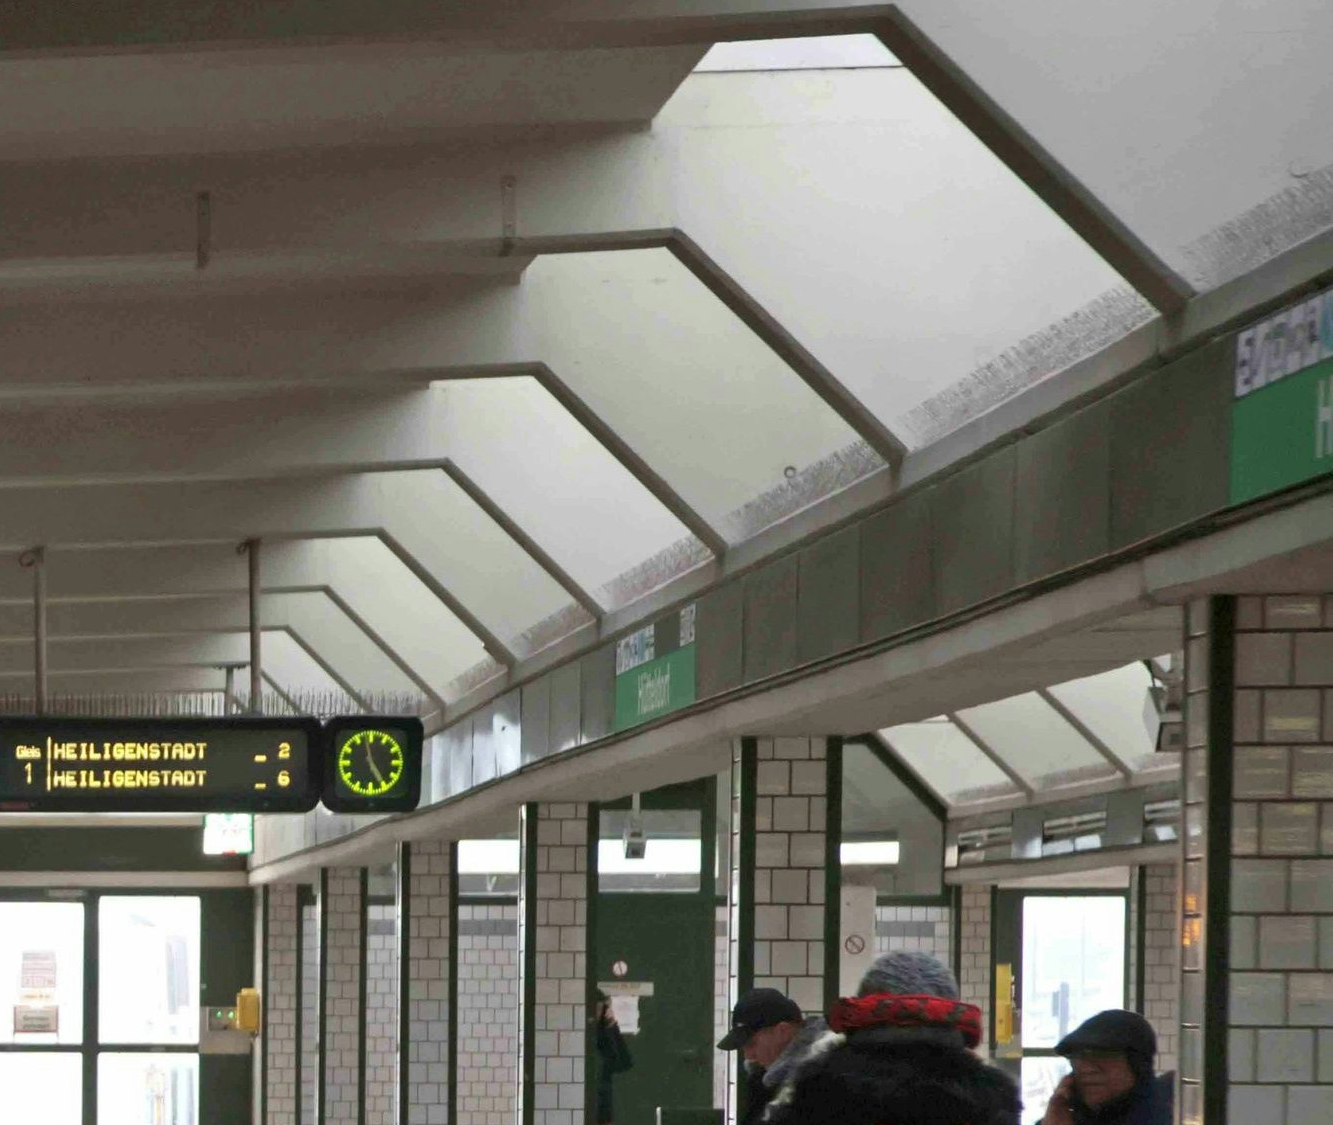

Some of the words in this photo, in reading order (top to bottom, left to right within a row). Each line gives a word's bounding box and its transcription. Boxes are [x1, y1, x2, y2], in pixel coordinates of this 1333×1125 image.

[15, 744, 42, 760] Gleis
[52, 742, 208, 761] HEILIGENSTADT
[277, 742, 292, 760] 2
[23, 761, 33, 785] 1
[52, 769, 208, 788] HEILIGENSTADT
[277, 770, 291, 787] 6
